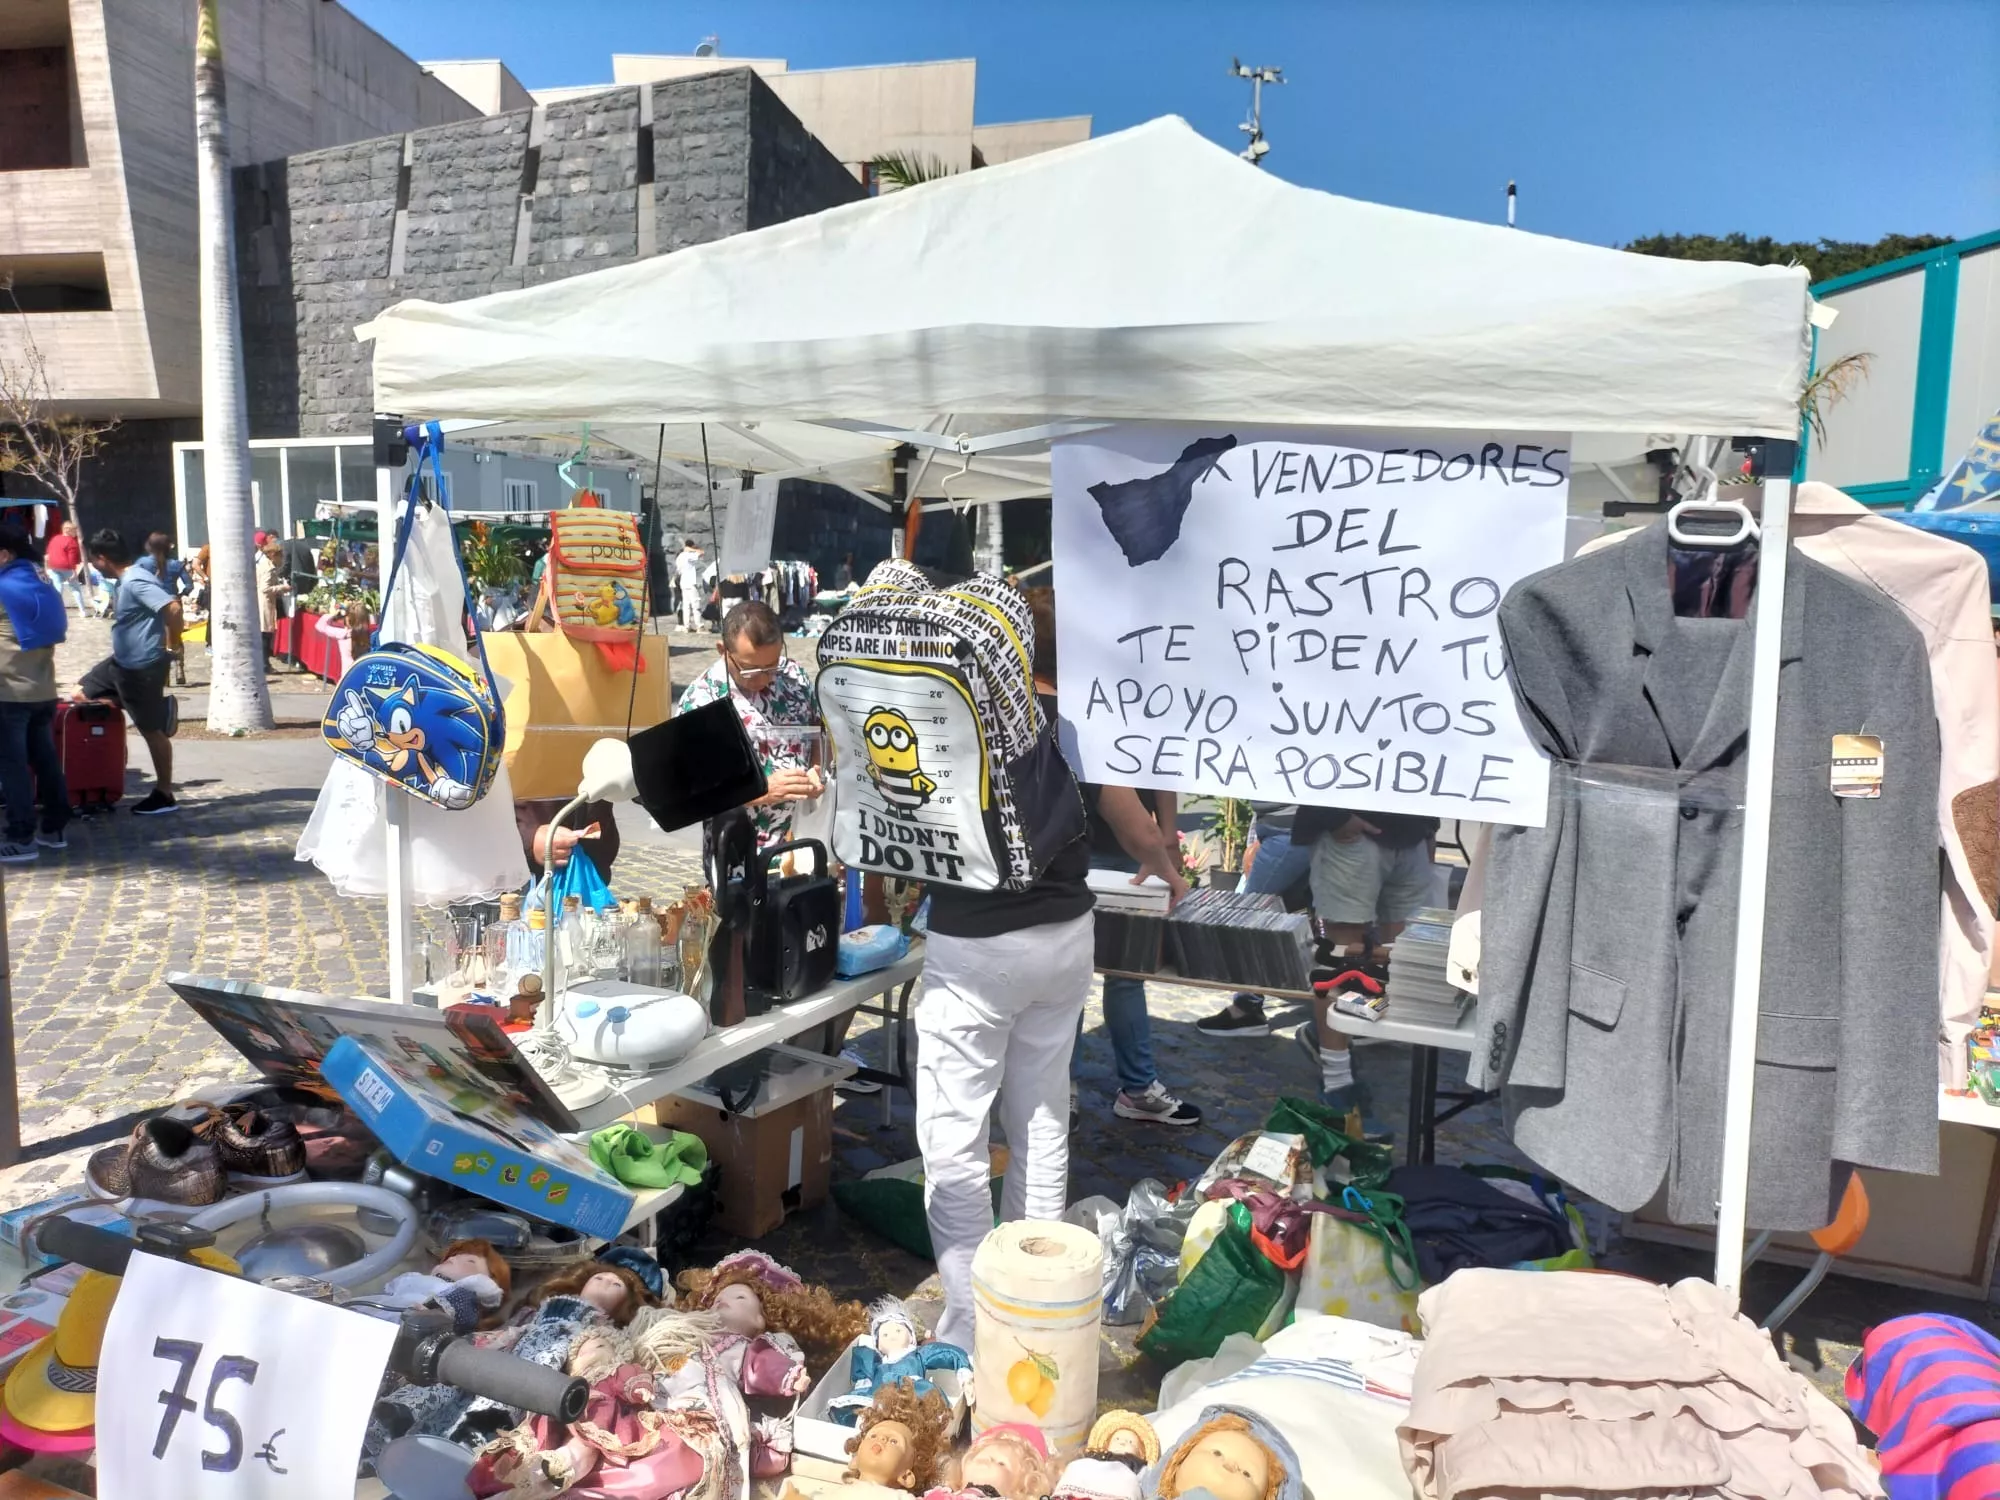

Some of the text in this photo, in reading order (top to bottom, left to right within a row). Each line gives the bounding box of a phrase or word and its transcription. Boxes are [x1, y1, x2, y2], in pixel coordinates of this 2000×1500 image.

[1251, 443, 1568, 499] VENDEDORES
[1272, 508, 1421, 556] DEL
[1217, 557, 1501, 620] RASTRO
[842, 616, 940, 637] STRIPES ARE IN
[855, 638, 879, 655] ARE
[884, 639, 897, 656] IN
[894, 595, 920, 606] ARE
[922, 598, 941, 610] IN
[954, 608, 1009, 649] MINION
[1005, 646, 1025, 677] LIFE
[923, 611, 980, 640] STRIPES
[979, 638, 1002, 667] ARE
[997, 663, 1012, 684] IN
[1117, 625, 1195, 663] TE
[1442, 635, 1509, 681] TU
[982, 663, 1017, 721] MINION
[1086, 677, 1238, 734] APOYO
[859, 809, 960, 851] I DIDN'T
[860, 833, 965, 882] DO IT
[359, 1072, 392, 1109] STEM
